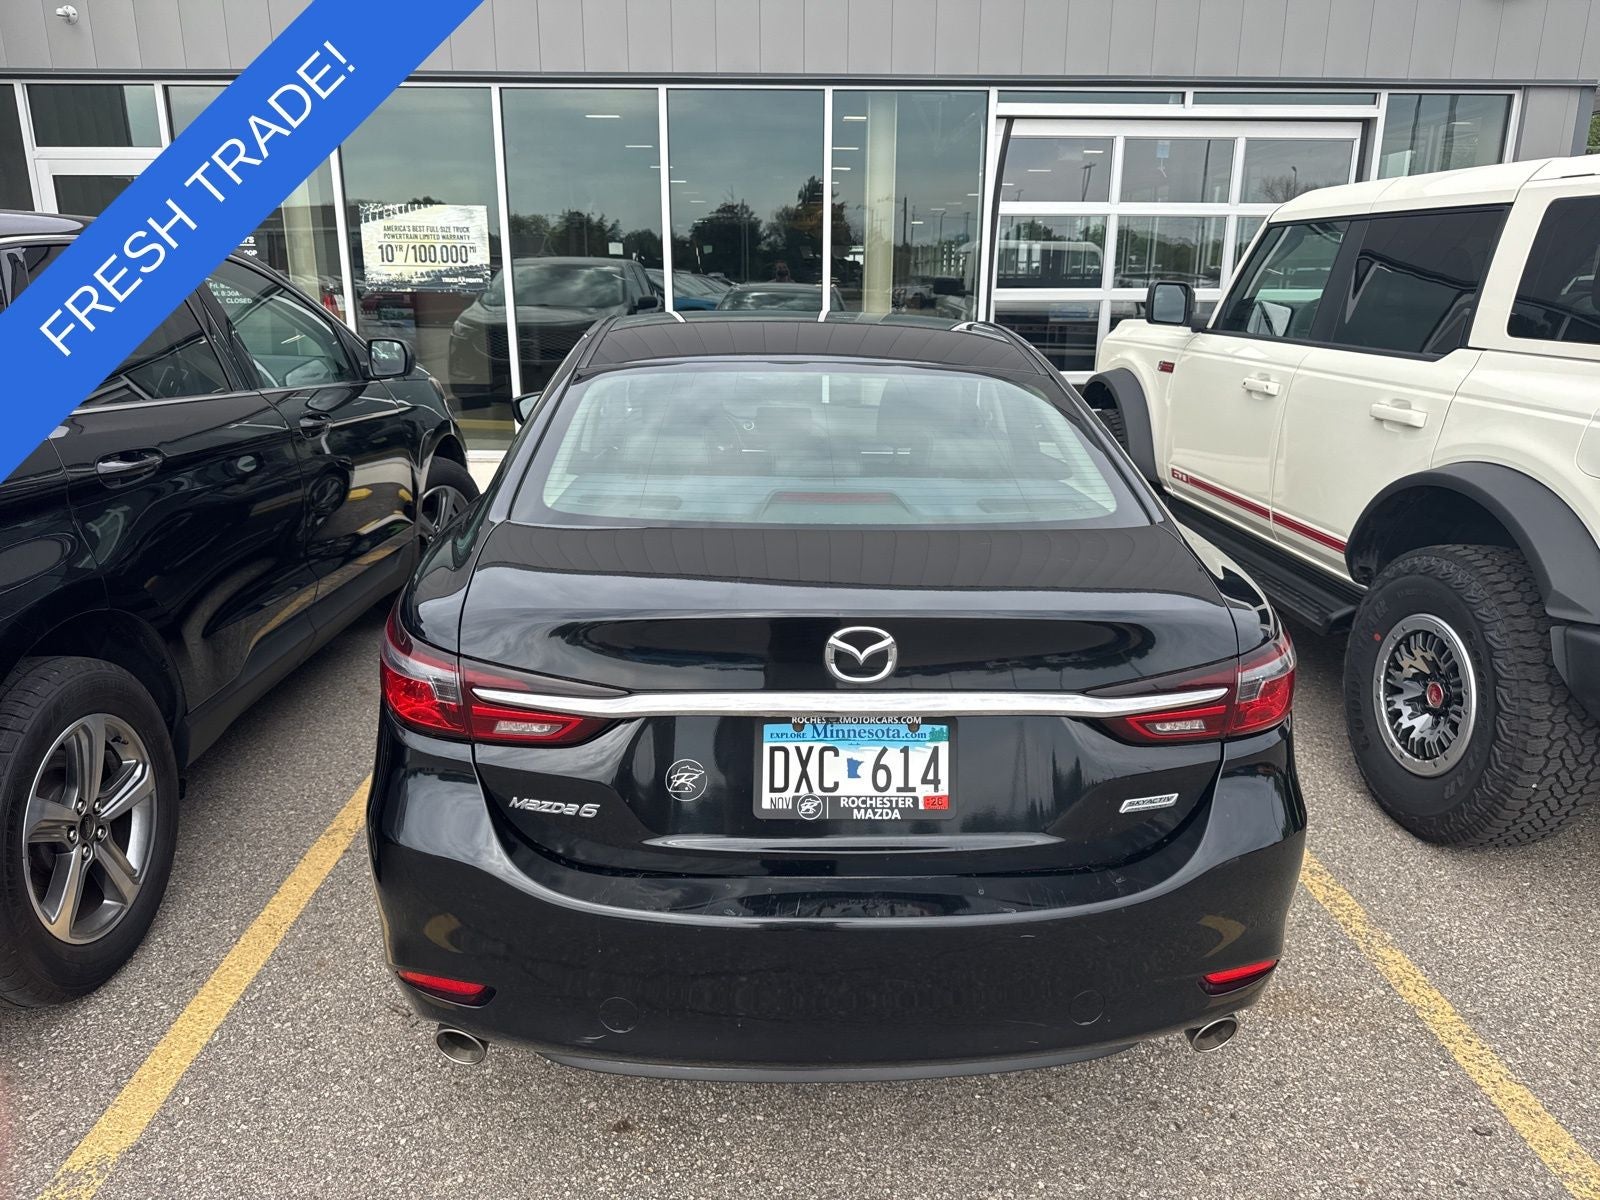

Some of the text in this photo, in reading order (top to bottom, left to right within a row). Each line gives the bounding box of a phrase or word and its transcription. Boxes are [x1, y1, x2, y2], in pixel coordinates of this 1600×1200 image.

[791, 716, 922, 724] ROCHESRMOTORCARS.COM
[769, 745, 942, 793] DXC 614
[770, 796, 793, 809] NOV
[840, 797, 914, 808] ROCHESTER
[853, 808, 902, 819] MAZDA
